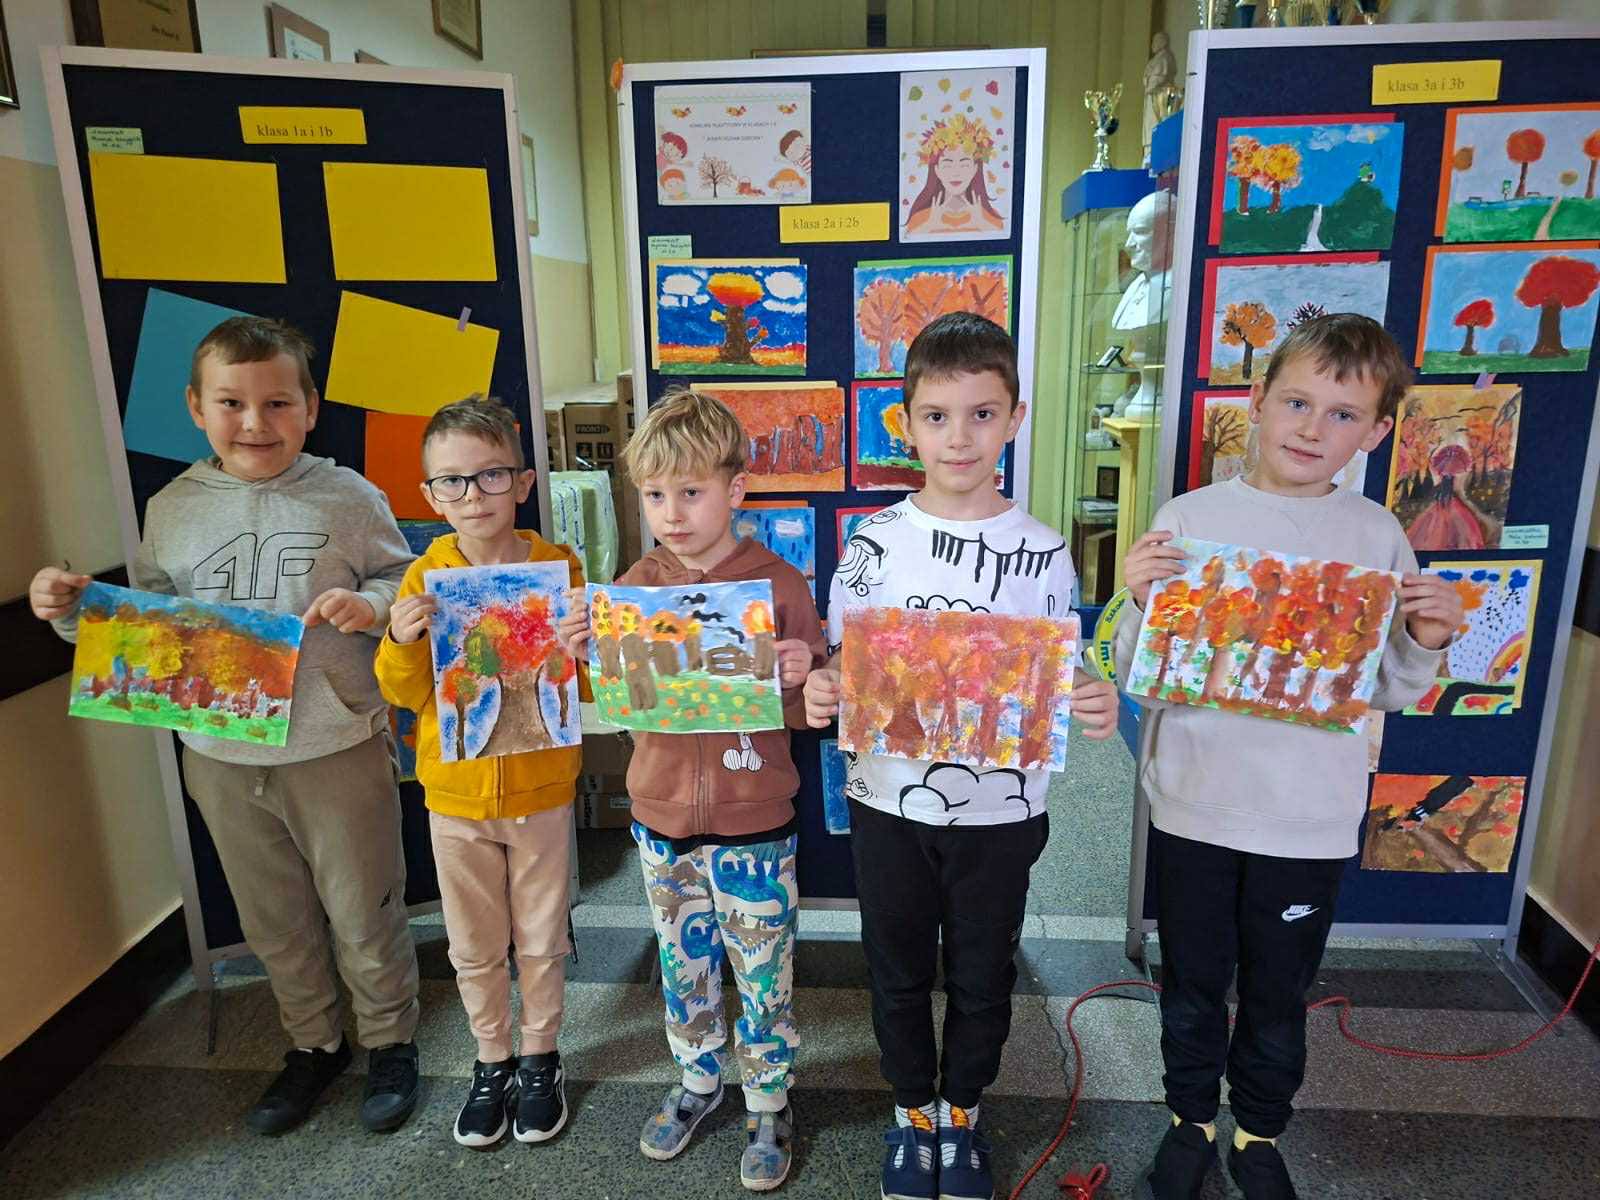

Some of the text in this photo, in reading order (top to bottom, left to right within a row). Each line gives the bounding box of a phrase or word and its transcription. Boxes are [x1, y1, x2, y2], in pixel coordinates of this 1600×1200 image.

[1387, 79, 1419, 93] klasa
[1423, 78, 1437, 91] 3a
[1448, 77, 1465, 91] 3b
[256, 124, 289, 137] klasa
[293, 125, 308, 137] 1a
[319, 125, 334, 137] 1b
[792, 218, 820, 230] klasa
[823, 217, 836, 229] 2a
[846, 216, 860, 229] 2b
[191, 532, 330, 600] 4F
